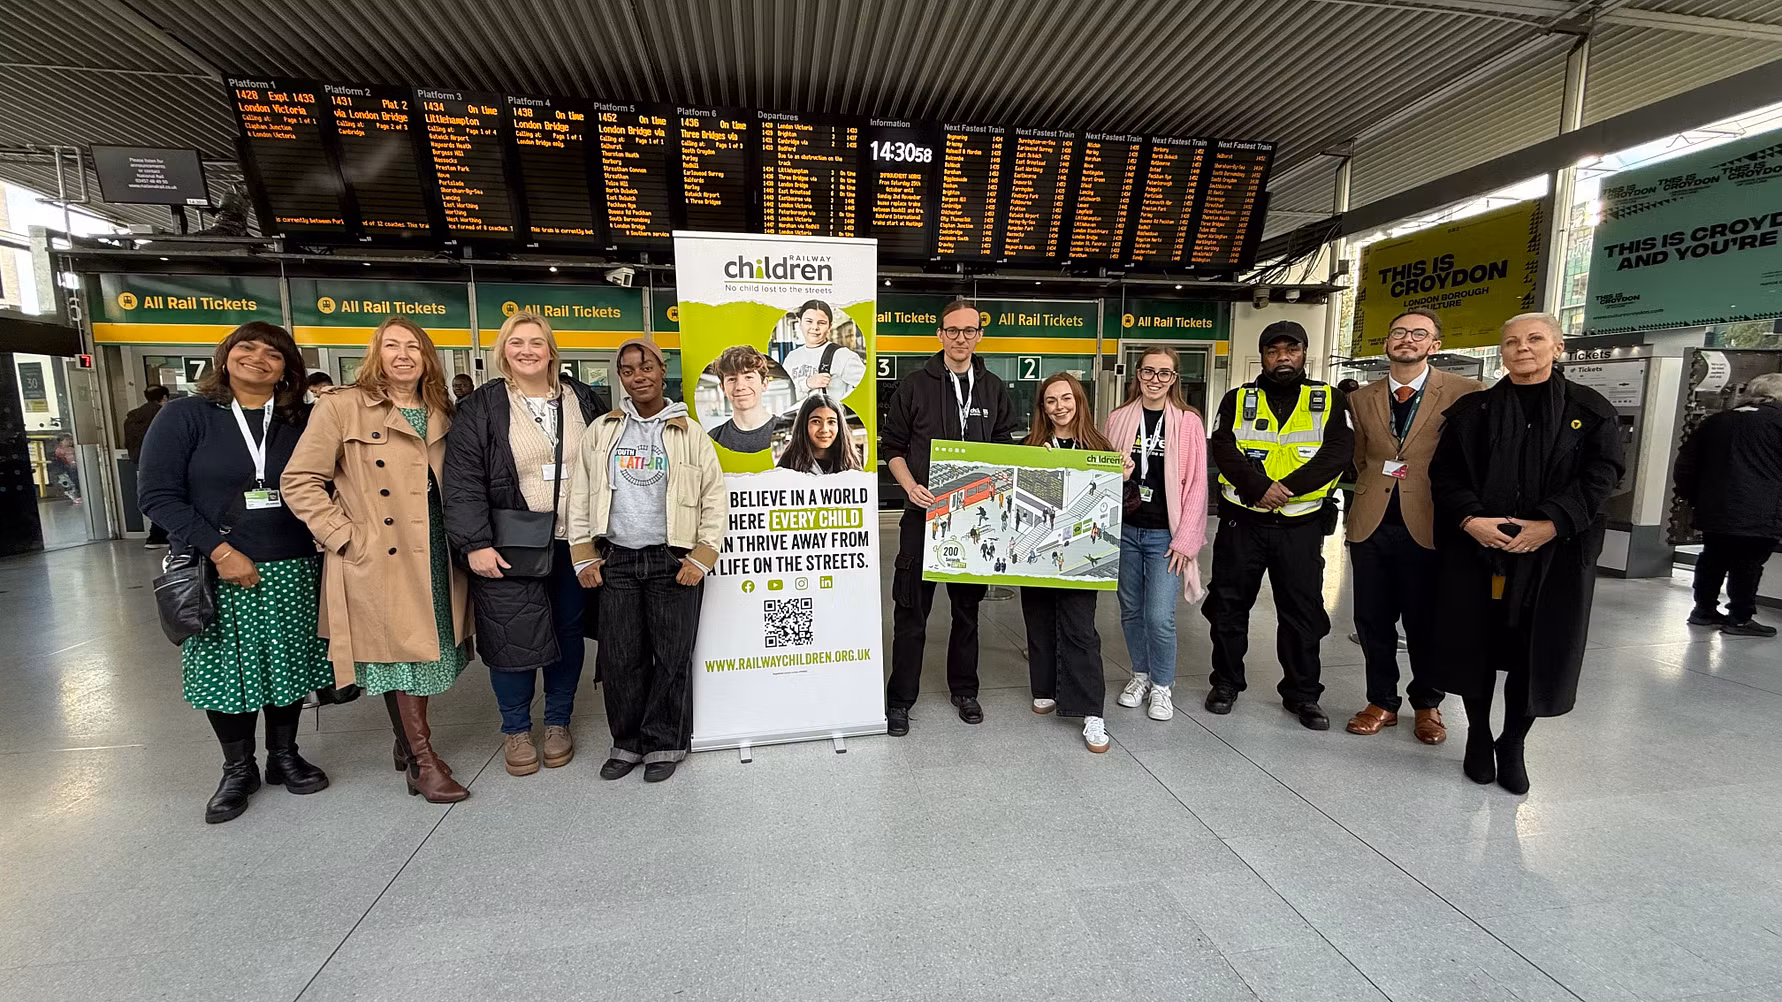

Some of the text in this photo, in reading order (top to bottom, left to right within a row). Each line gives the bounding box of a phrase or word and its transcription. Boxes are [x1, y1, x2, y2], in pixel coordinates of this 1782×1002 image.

[228, 78, 276, 89] Platform 1
[324, 85, 363, 95] Platform
[236, 90, 315, 103] 1428 Expt 1433
[417, 90, 455, 100] Platform
[508, 96, 550, 107] Platform 4
[238, 102, 307, 115] London Victoria
[331, 96, 408, 110] 1431 Plat 2
[424, 102, 498, 115] 1434 On time
[594, 102, 628, 112] Platform
[334, 109, 408, 122] via London Bridge
[513, 107, 584, 121] 1438 On time
[677, 107, 709, 117] Platform
[758, 111, 798, 121] Departures
[242, 114, 262, 122] Calling
[284, 116, 296, 124] Page
[425, 114, 480, 126] Littlehampton
[514, 119, 569, 132] London Bridge
[598, 113, 667, 125] 1452 On time
[681, 118, 746, 130] 1436 On time
[870, 119, 910, 128] Information
[599, 124, 665, 137] London Bridge via
[681, 129, 738, 141] Three Bridges via
[944, 123, 1004, 134] Next Fastest Train
[1033, 129, 1057, 137] Fastest
[536, 139, 551, 147] Bridge
[1085, 132, 1100, 140] Next
[1102, 133, 1125, 141] Fastest
[1168, 137, 1190, 146] Fastest
[1233, 142, 1256, 150] Fastest
[1722, 161, 1767, 175] THIS IS
[1658, 173, 1697, 185] THIS IS
[1663, 175, 1720, 191] CROYDON
[1604, 237, 1657, 258] THIS
[1662, 231, 1685, 248] IS
[1617, 230, 1778, 271] AND YOU'RE
[724, 255, 833, 281] children
[1379, 254, 1454, 284] THIS IS
[1390, 260, 1508, 298] CROYDON
[726, 284, 737, 292] No
[740, 284, 759, 292] child
[761, 284, 776, 293] lost
[144, 296, 257, 311] All Rail Tickets
[1404, 287, 1489, 307] LONDON BOROUGH
[341, 301, 446, 315] All Rail Tickets
[525, 305, 621, 318] All Rail Tickets
[877, 312, 936, 323] ail Tickets
[999, 313, 1083, 327] All Rail Tickets
[1138, 316, 1213, 328] All Rail Tickets
[83, 356, 90, 367] 7
[1568, 350, 1611, 360] Tickets
[190, 360, 206, 380] 7
[561, 363, 572, 377] 5
[878, 359, 890, 376] 3
[1024, 358, 1035, 379] 2
[730, 488, 868, 508] BELIEVE IN A WORLD
[729, 510, 859, 530] HERE EVERY CHILD
[737, 535, 787, 552] THRIVE
[792, 533, 828, 550] AWAY
[832, 531, 868, 548] FROM
[943, 547, 958, 556] 200
[720, 558, 750, 575] LIFE
[754, 557, 772, 573] ON
[776, 555, 802, 572] THE
[806, 553, 868, 570] STREETS.
[705, 649, 871, 673] WWW.RAILWAYCHILDREN.ORG.UK
